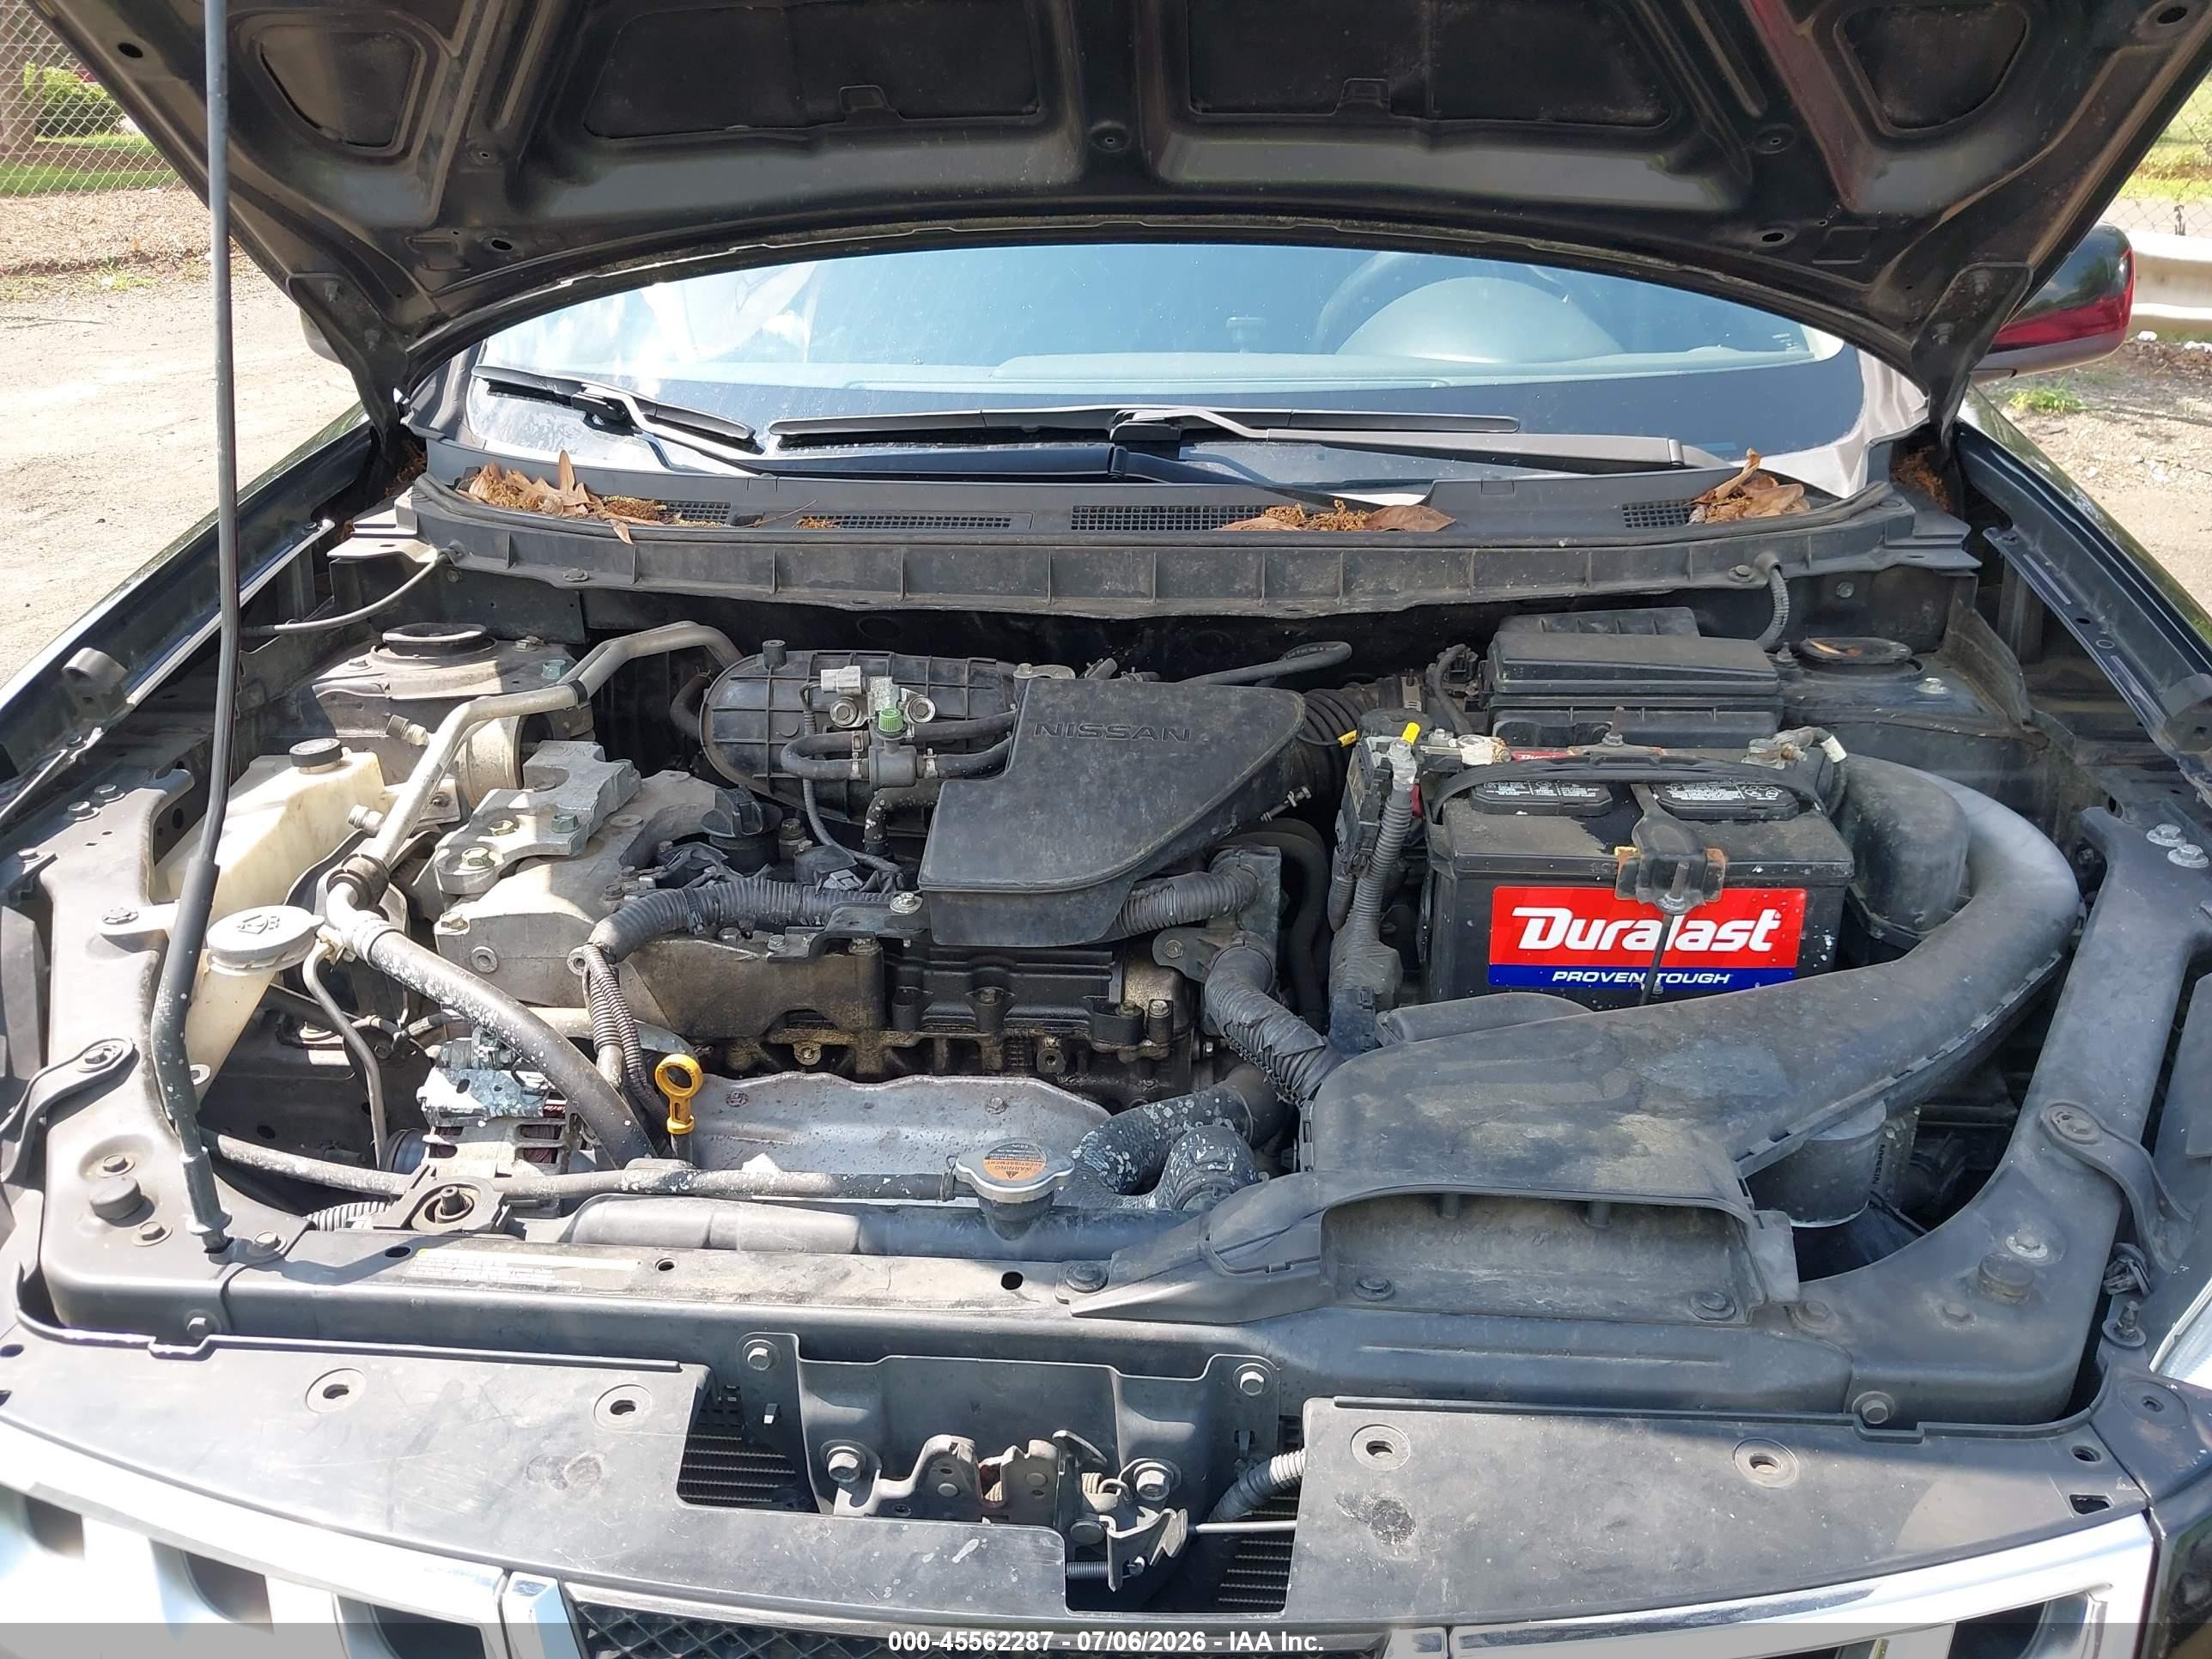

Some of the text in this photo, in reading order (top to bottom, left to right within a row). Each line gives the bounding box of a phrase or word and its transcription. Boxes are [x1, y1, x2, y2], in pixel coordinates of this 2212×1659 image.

[1034, 722, 1192, 742] NISSAN
[1511, 907, 1782, 952] Duralast
[1552, 970, 1731, 984] PROVEN TOUGH
[1871, 1143, 1886, 1185] NISSAN
